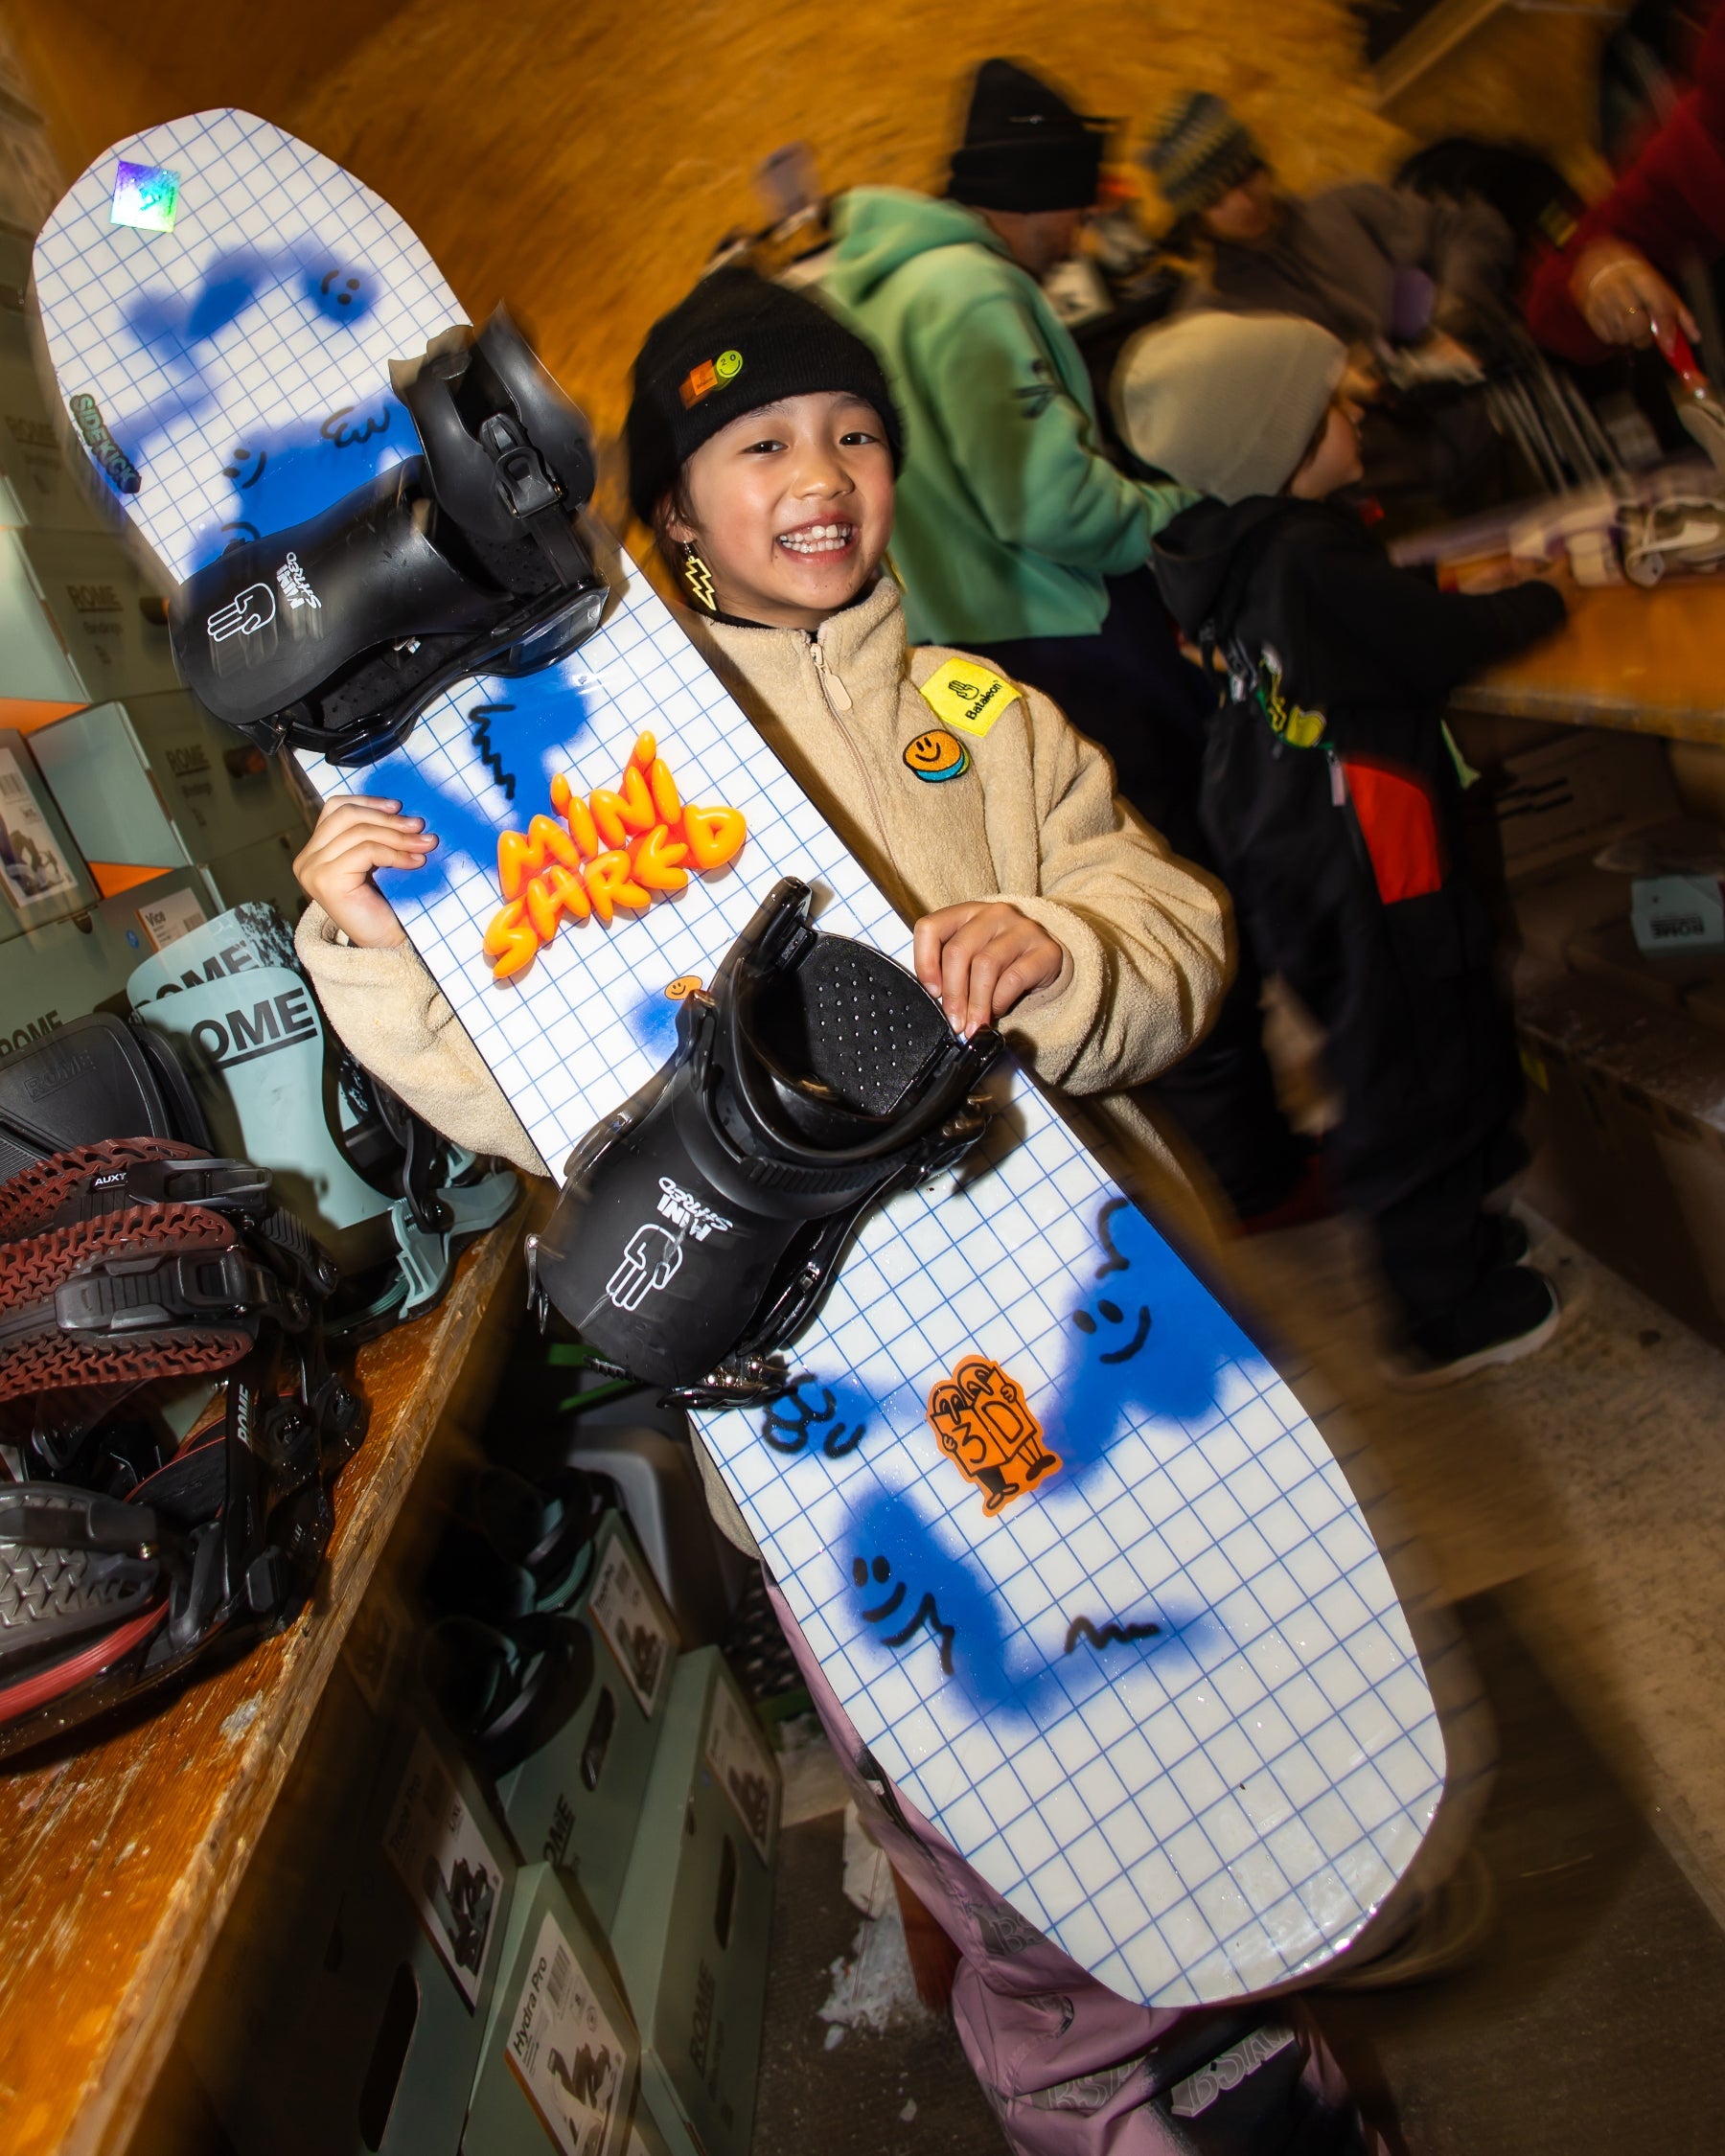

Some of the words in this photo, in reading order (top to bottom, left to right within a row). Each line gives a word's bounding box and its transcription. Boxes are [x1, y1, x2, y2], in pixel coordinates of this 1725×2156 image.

[71, 395, 141, 493] SIDEKICK
[66, 585, 122, 611] ROME
[965, 682, 1002, 721] Bataleon
[497, 730, 681, 900] MINI
[483, 804, 747, 978] SHRED
[190, 987, 318, 1062] OME
[656, 1192, 713, 1242] MINI
[658, 1177, 733, 1232] SHRED
[542, 1793, 570, 1865] OME
[513, 1992, 538, 2056] Hydra
[531, 1957, 547, 1993] Pro
